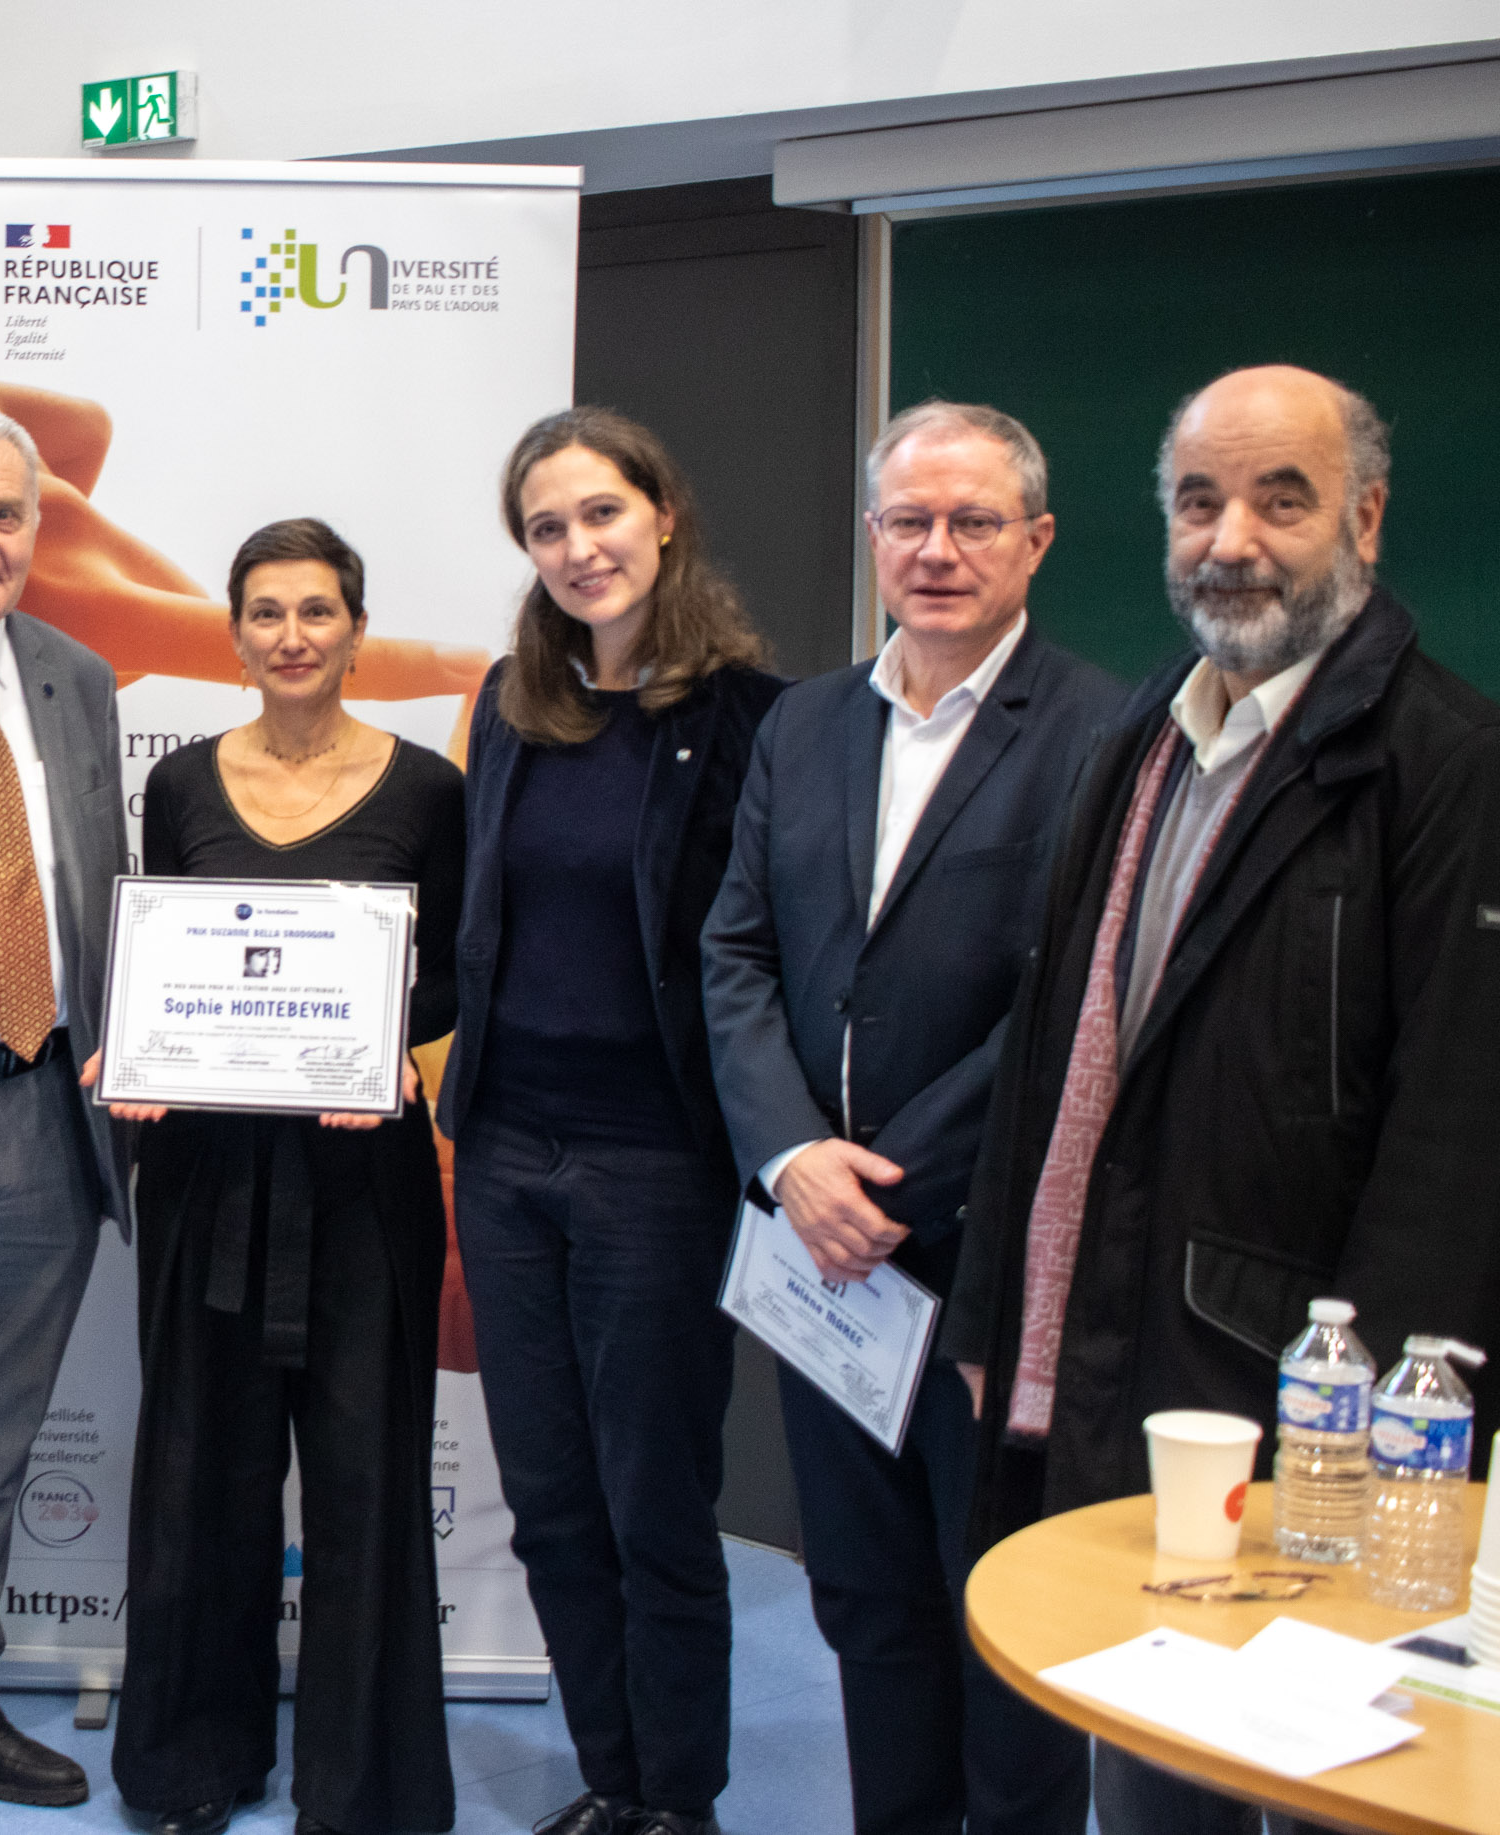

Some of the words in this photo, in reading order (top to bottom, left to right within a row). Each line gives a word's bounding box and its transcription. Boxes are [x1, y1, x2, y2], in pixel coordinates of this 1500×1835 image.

[4, 255, 159, 283] RÉPUBLIQUE
[392, 284, 409, 295] DE
[416, 284, 444, 295] PAU
[451, 285, 466, 296] ET
[473, 285, 499, 296] DES
[4, 286, 148, 308] FRANÇAISE
[392, 300, 421, 311] PAYS
[425, 300, 441, 312] DE
[444, 300, 499, 312] L'ADOUR
[4, 315, 48, 328] Liberté
[4, 330, 48, 346] Égalité
[4, 349, 66, 361] Fraternité
[186, 927, 207, 936] PRIX
[254, 929, 280, 938] BELLA
[164, 997, 223, 1019] Sophie
[231, 999, 351, 1019] HONTEBEYRIE
[31, 1491, 79, 1502] FRANCE
